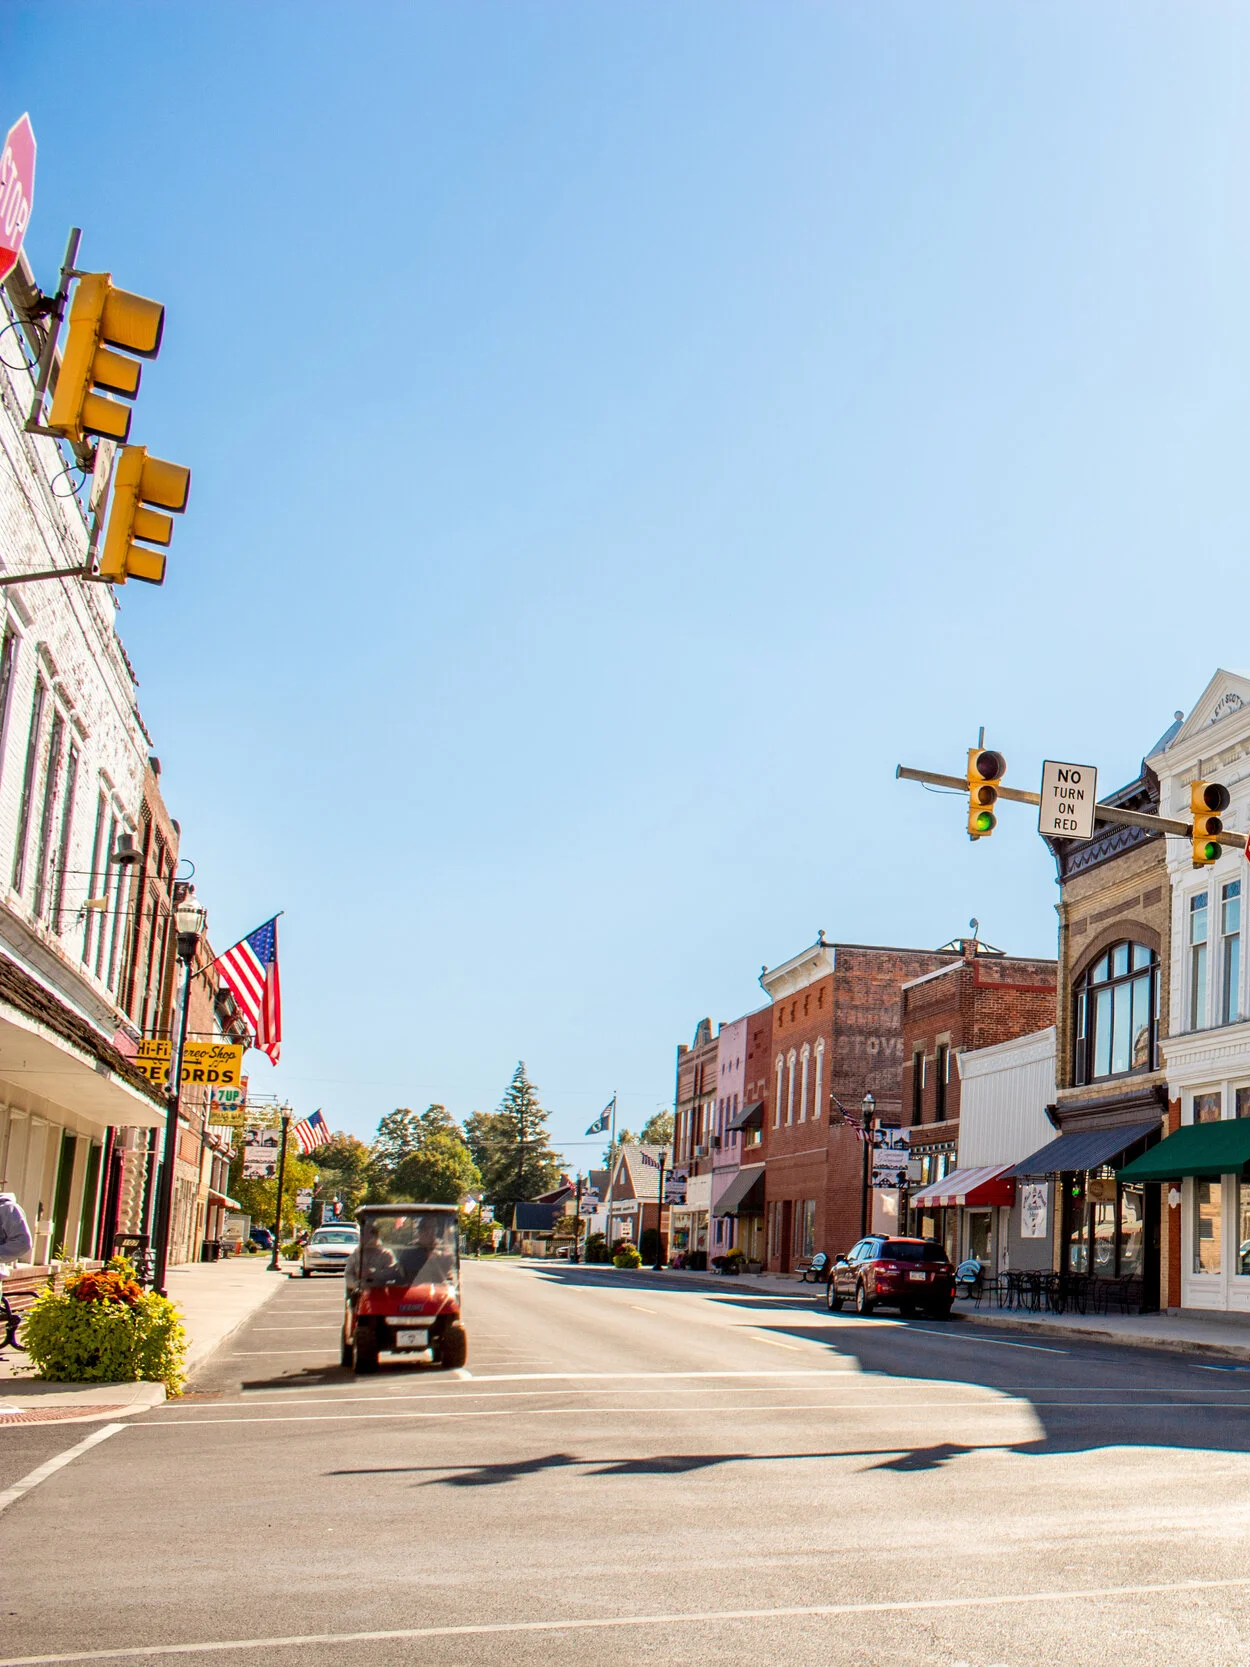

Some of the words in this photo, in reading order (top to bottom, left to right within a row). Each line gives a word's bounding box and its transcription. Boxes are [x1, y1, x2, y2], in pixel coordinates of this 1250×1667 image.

[0, 146, 28, 248] STOP
[1057, 768, 1081, 785] NO
[1053, 786, 1084, 801] TURN
[1058, 802, 1075, 815] ON
[1054, 817, 1078, 832] RED
[137, 1042, 168, 1056] Hi-Fi
[208, 1046, 236, 1063] Shop
